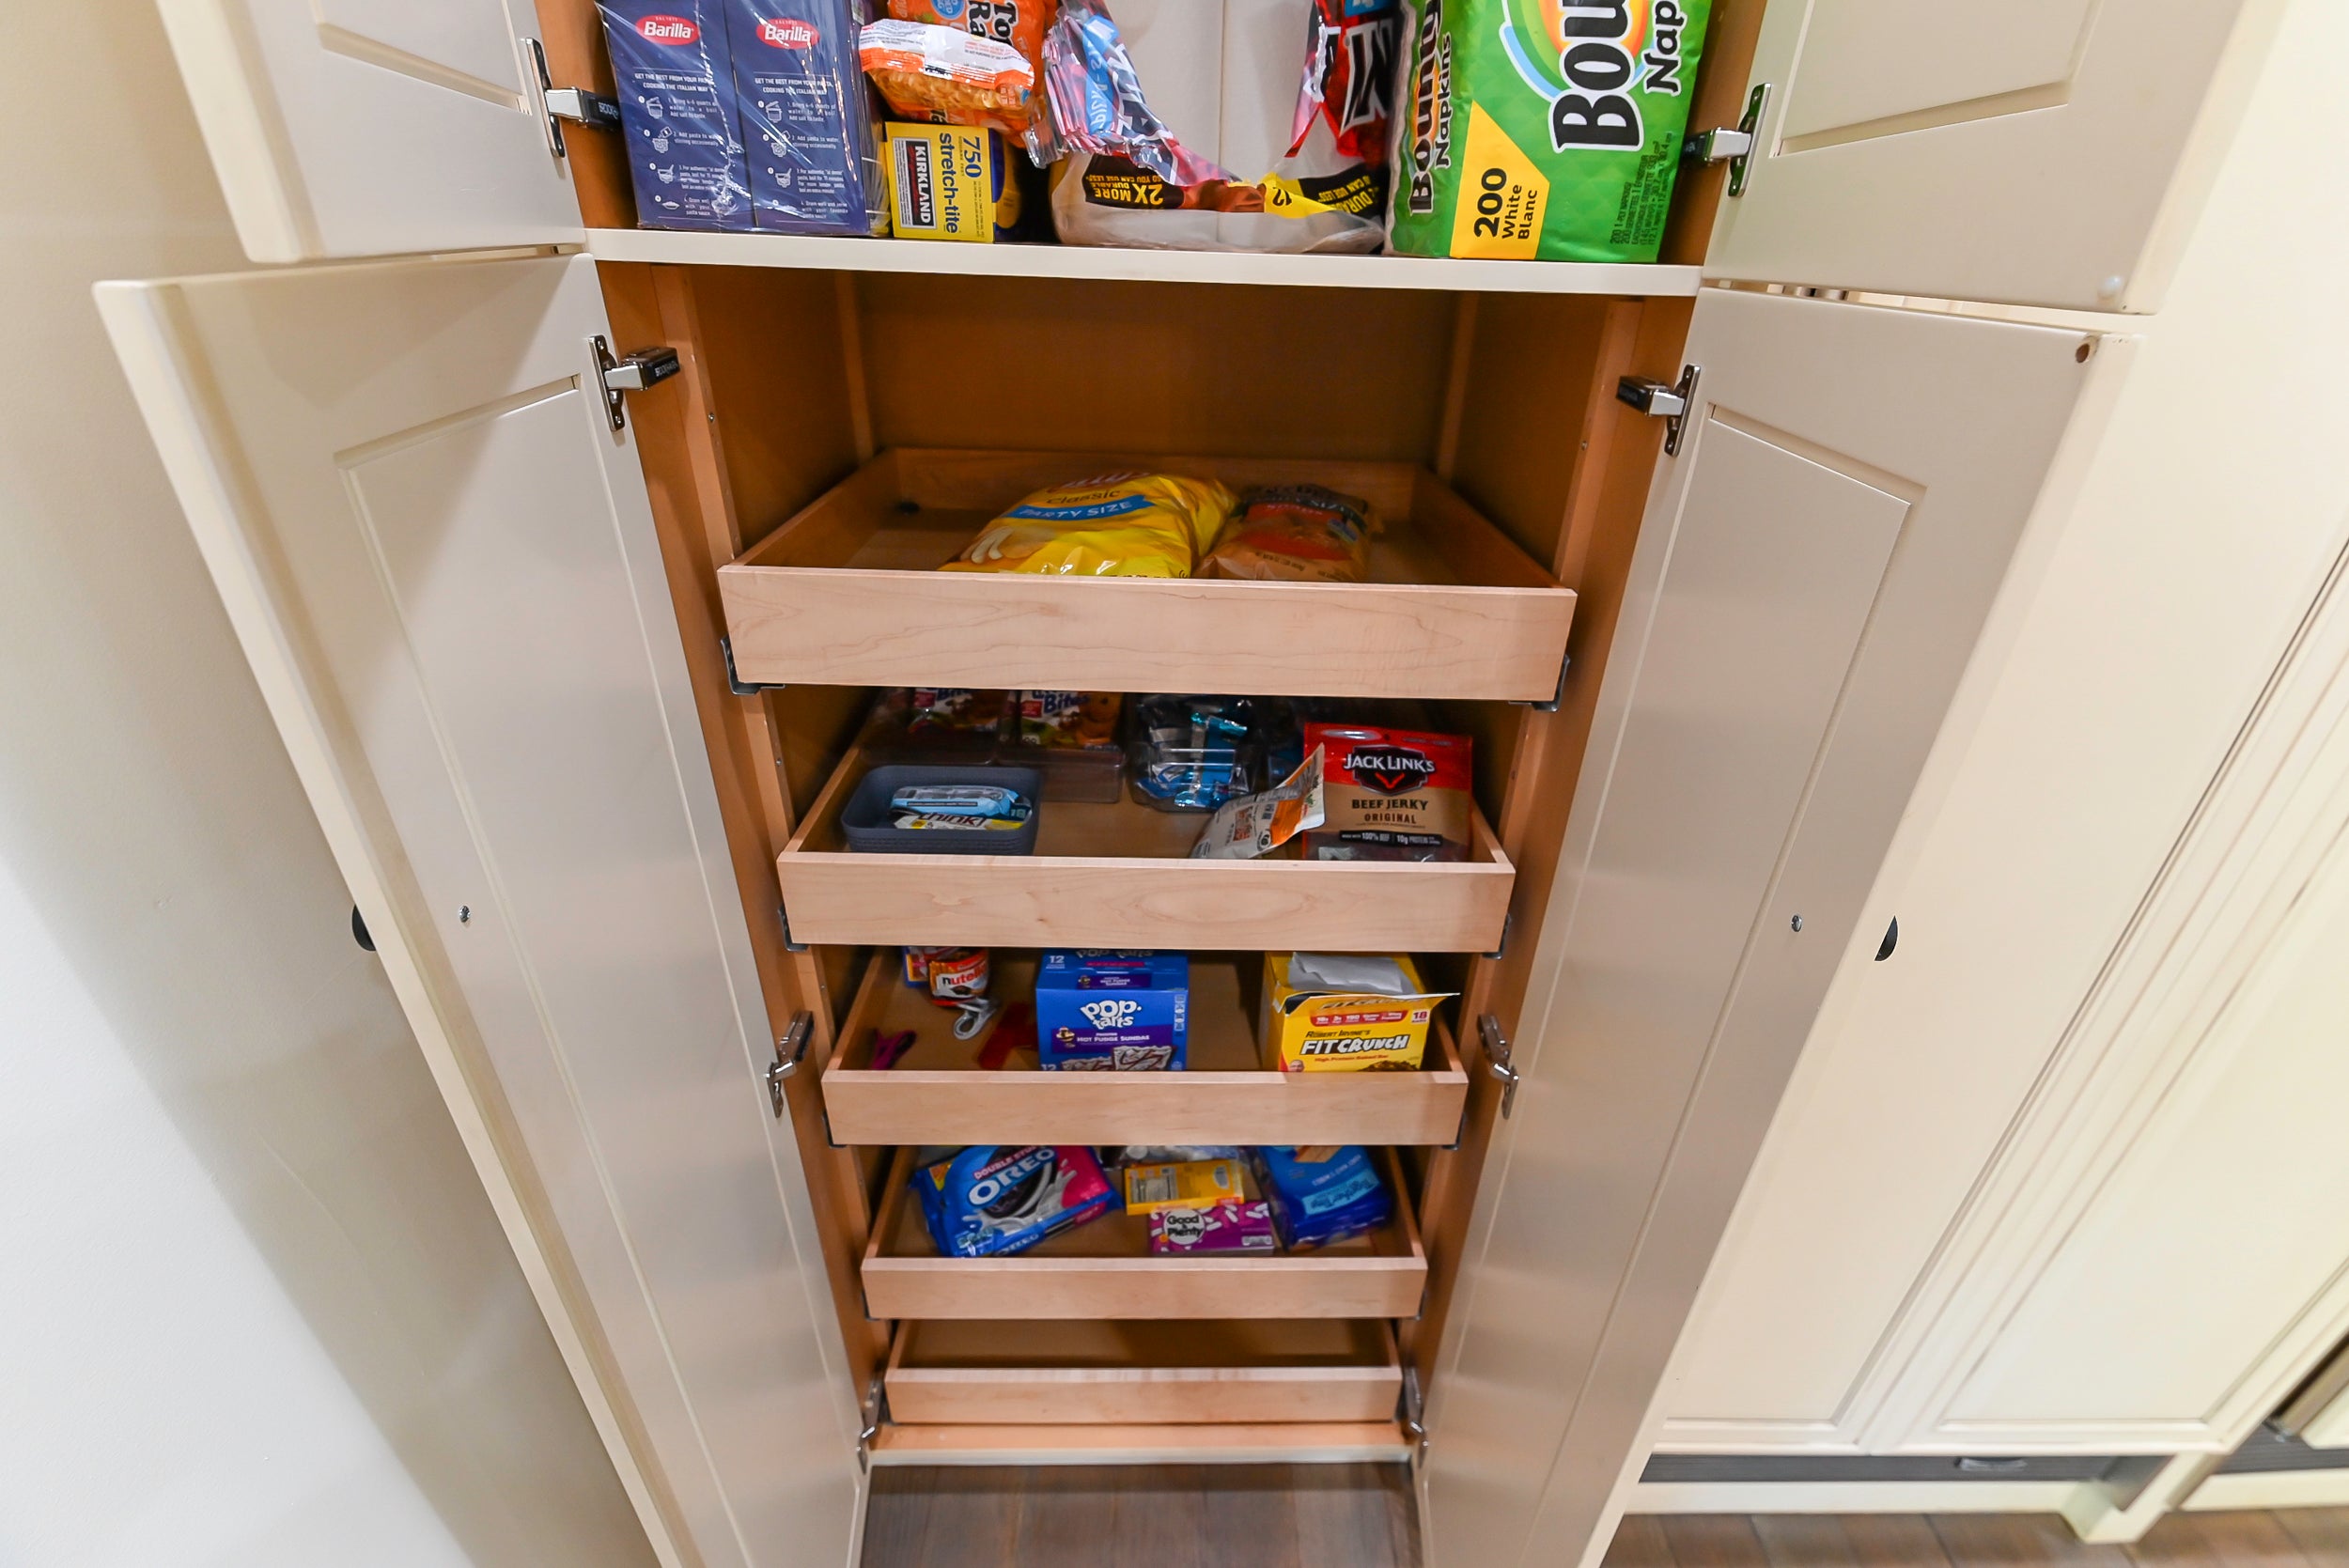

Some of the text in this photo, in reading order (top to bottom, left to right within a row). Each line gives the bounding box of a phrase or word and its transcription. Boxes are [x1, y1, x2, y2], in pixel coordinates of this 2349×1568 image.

[644, 21, 692, 39] Barilla
[764, 23, 811, 42] Barilla
[1646, 0, 1685, 93] Nap
[1410, 0, 1440, 214] Bounty
[1437, 35, 1451, 167] Napkins
[963, 136, 982, 179] 750
[915, 146, 931, 224] KIRKLAND
[940, 132, 959, 233] stretch-tite
[1346, 179, 1363, 194] CAN
[1093, 183, 1164, 206] 2X MORE
[1474, 168, 1507, 237] 200
[1501, 184, 1523, 240] White
[1518, 190, 1538, 240] Blanc
[1046, 489, 1120, 505] Classic
[1019, 500, 1131, 520] PARTY SIZE
[1344, 753, 1435, 772] JACK LINK'S
[1352, 799, 1428, 811] BEEF JERKY
[1364, 813, 1416, 824] ORIGINAL
[1050, 955, 1065, 964] 12
[1412, 1011, 1427, 1019] 18
[1300, 1034, 1409, 1054] FITCRUNCH
[968, 1148, 1055, 1206] OREO
[973, 1156, 1014, 1181] DOUBLE
[1166, 1215, 1200, 1225] Good
[1167, 1226, 1204, 1238] Plenty
